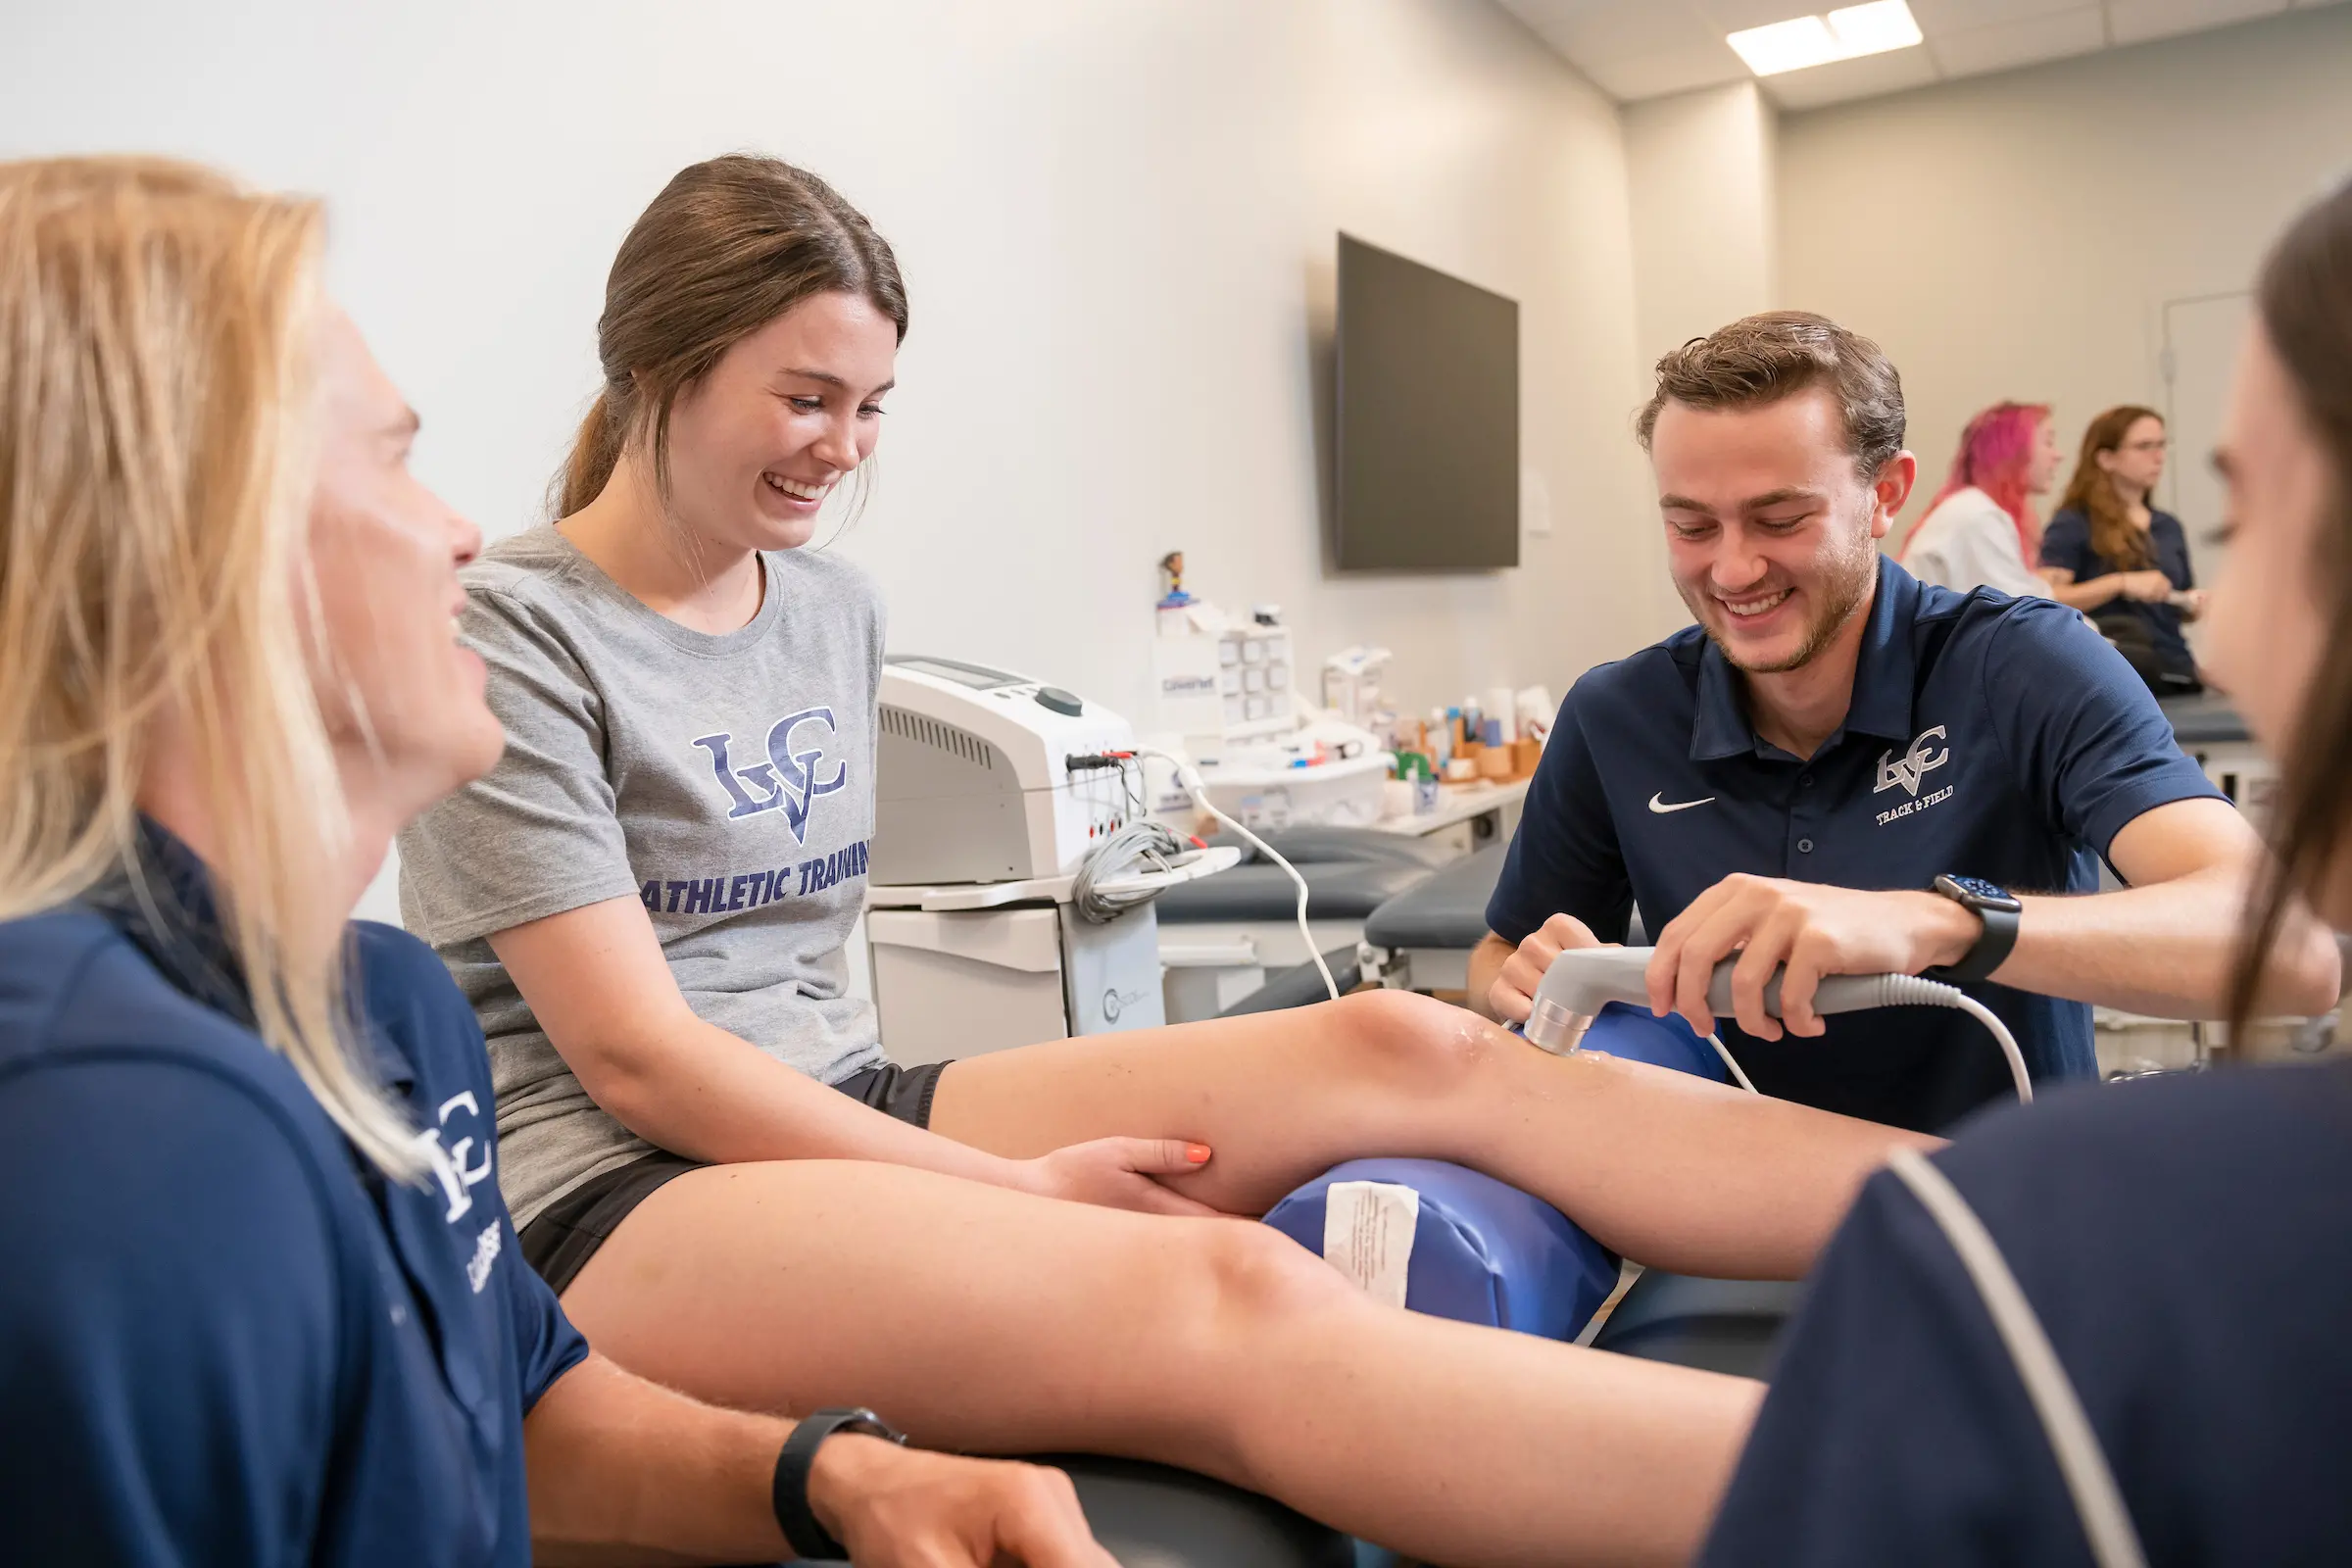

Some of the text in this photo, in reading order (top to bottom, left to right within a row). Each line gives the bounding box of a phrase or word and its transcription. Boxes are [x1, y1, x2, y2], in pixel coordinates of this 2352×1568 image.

[1876, 785, 1954, 826] TRACK & FIELD
[639, 866, 791, 913] ATHLETIC
